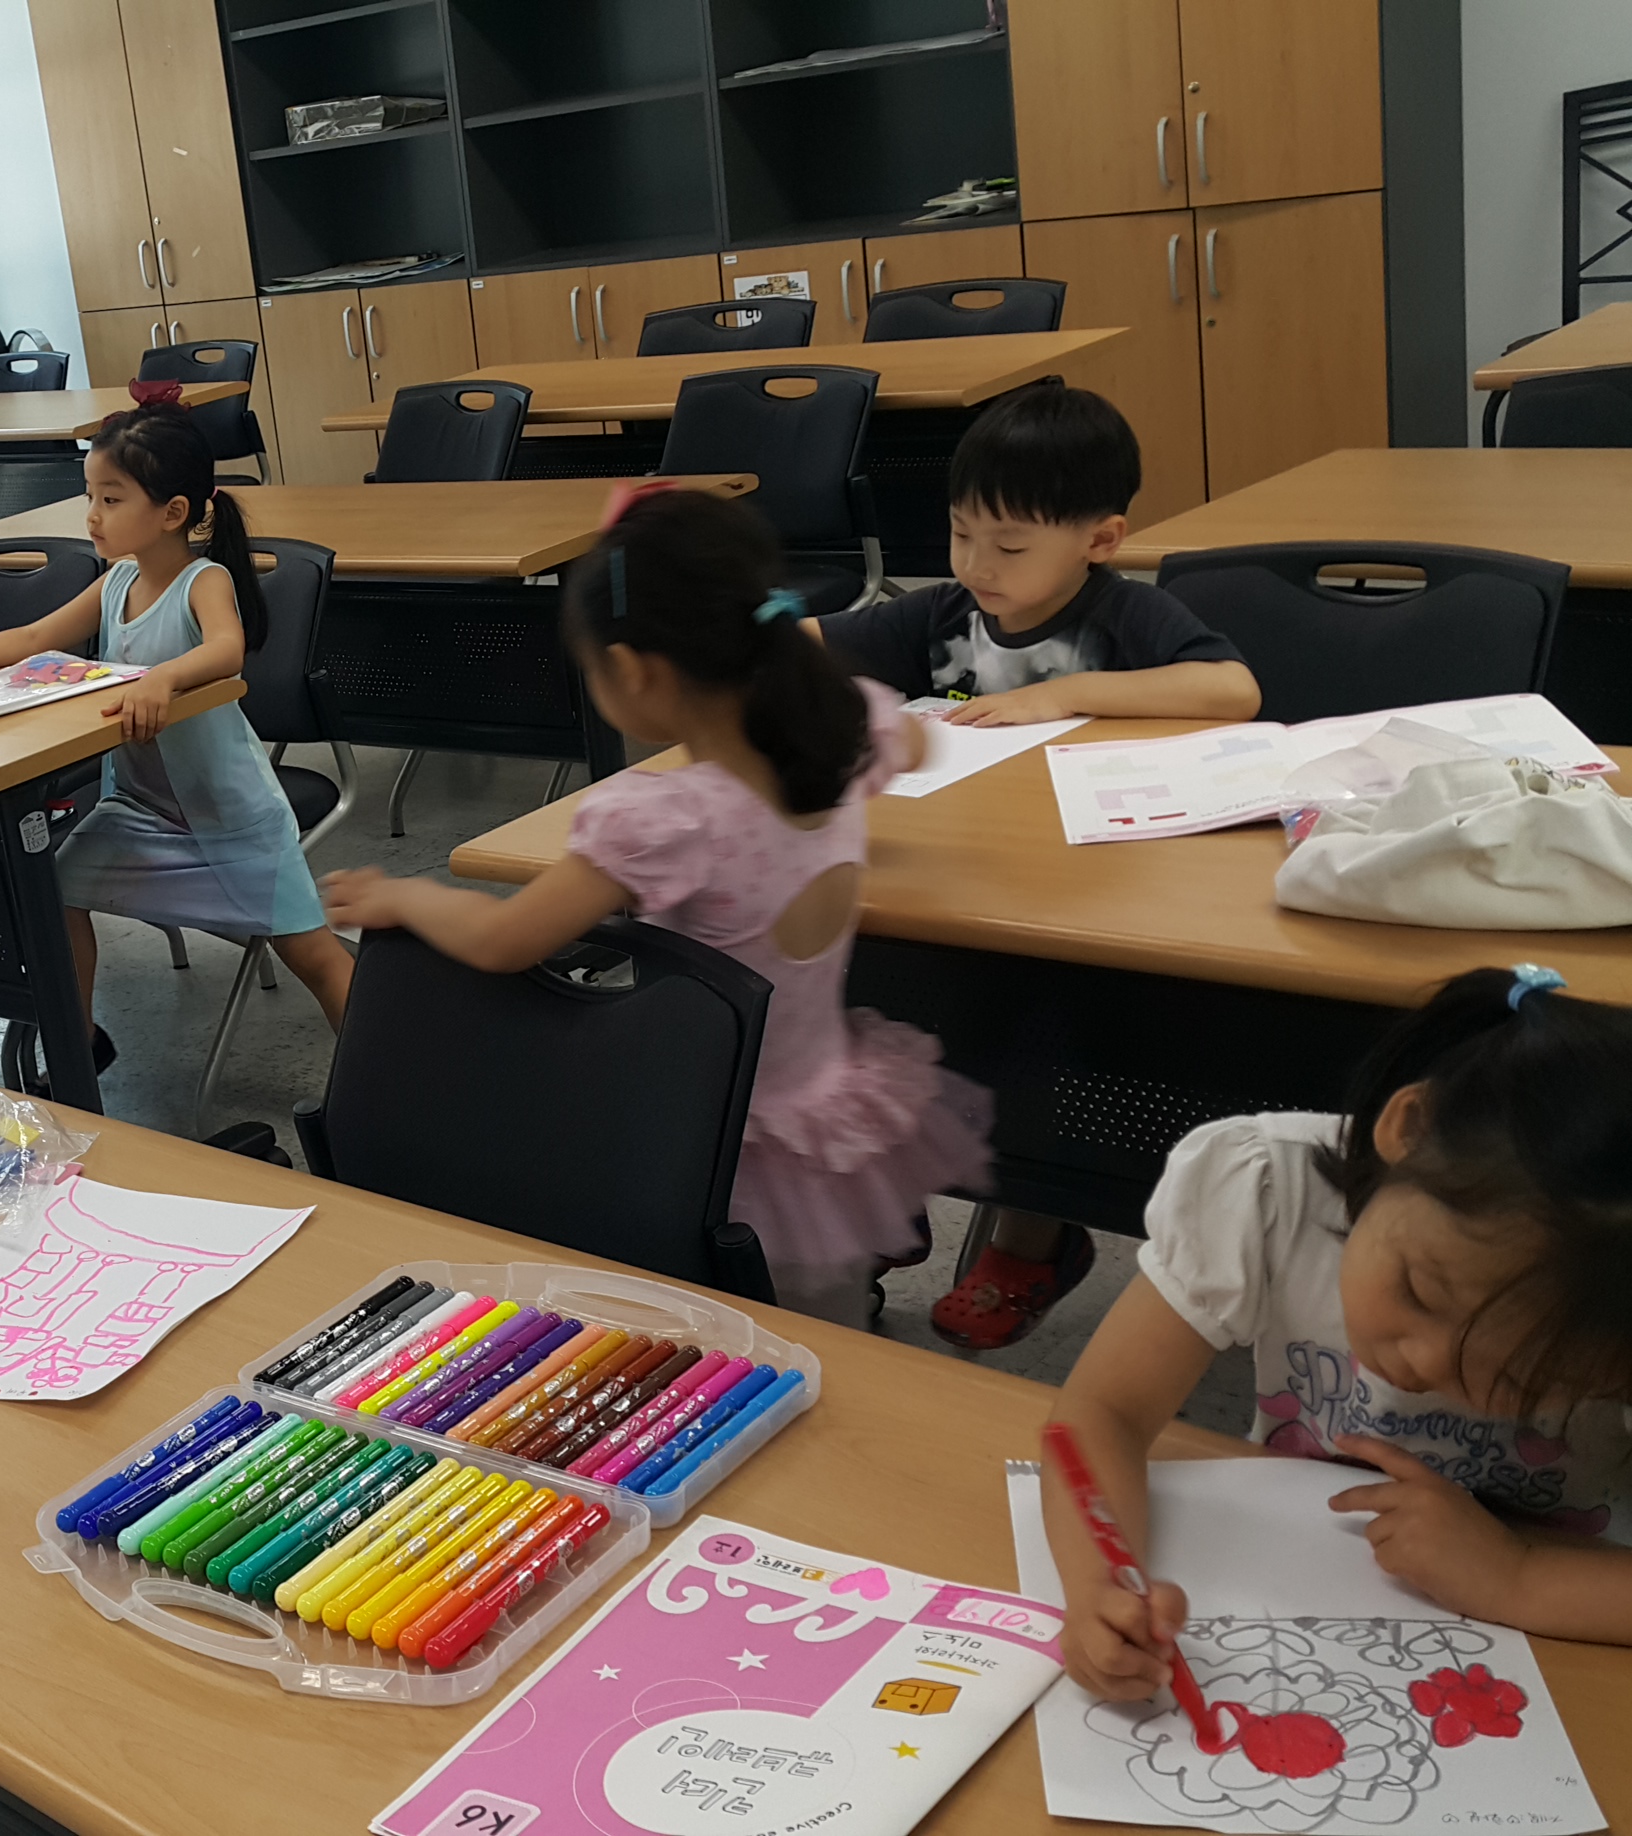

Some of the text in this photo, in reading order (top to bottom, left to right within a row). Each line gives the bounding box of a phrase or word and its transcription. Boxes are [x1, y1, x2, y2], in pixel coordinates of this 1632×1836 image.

[922, 1630, 983, 1650] 미노스
[657, 1725, 834, 1778] 큐브레인
[661, 1769, 766, 1816] 킨더
[455, 1804, 516, 1836] K6
[785, 1802, 852, 1833] Creative
